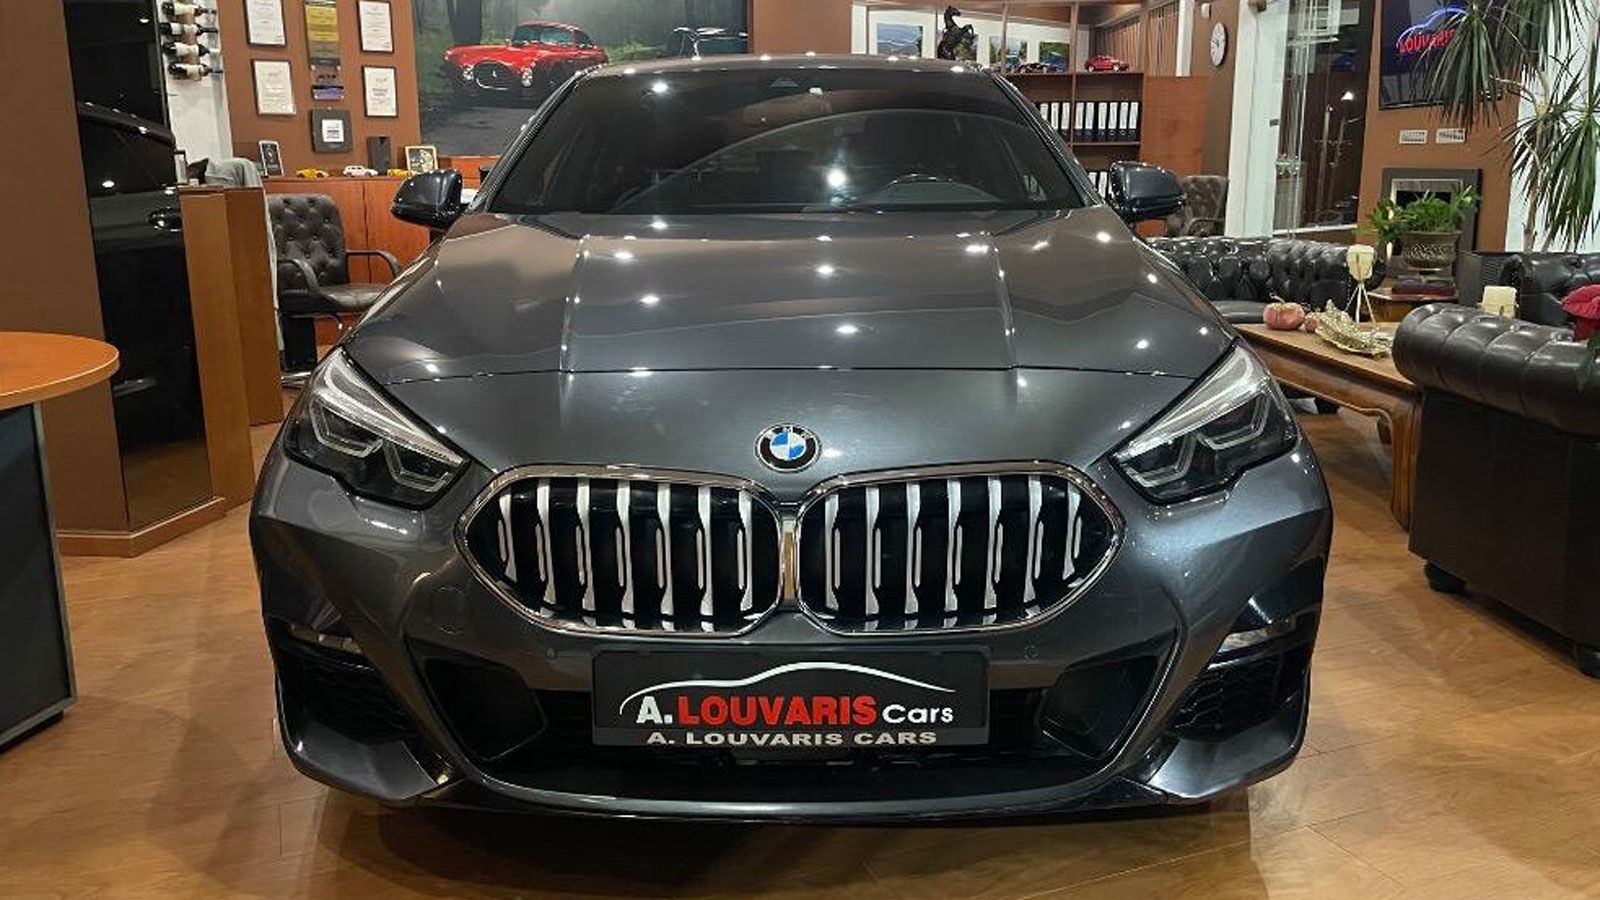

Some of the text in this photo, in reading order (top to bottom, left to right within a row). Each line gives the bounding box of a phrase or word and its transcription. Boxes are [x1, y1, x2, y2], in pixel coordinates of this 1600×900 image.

[882, 703, 954, 724] Cars
[647, 731, 937, 746] A. LOUVARIS CARS
